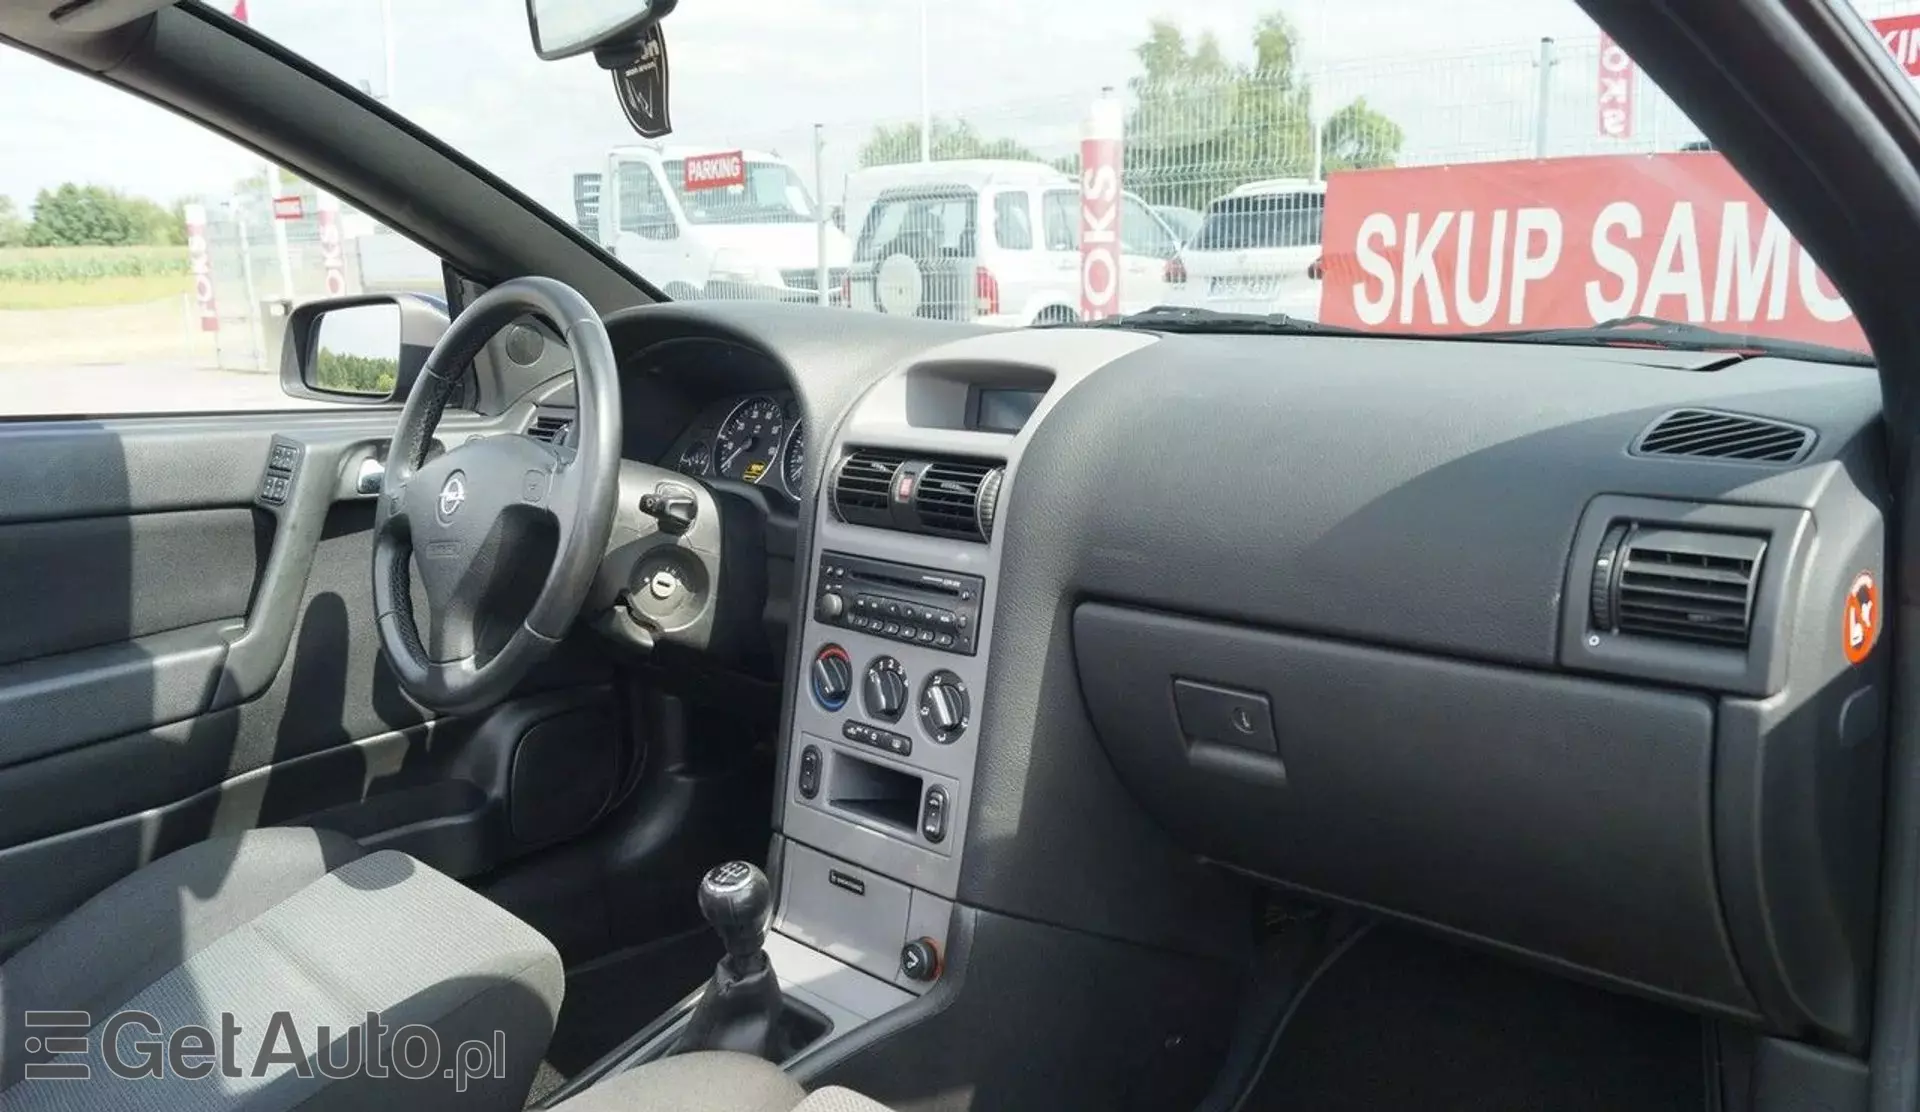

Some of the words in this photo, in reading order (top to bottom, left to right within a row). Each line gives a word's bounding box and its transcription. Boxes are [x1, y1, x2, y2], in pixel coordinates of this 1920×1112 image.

[687, 156, 741, 182] PARKING
[1084, 164, 1117, 321] OKS
[1353, 207, 1563, 326] SKUP
